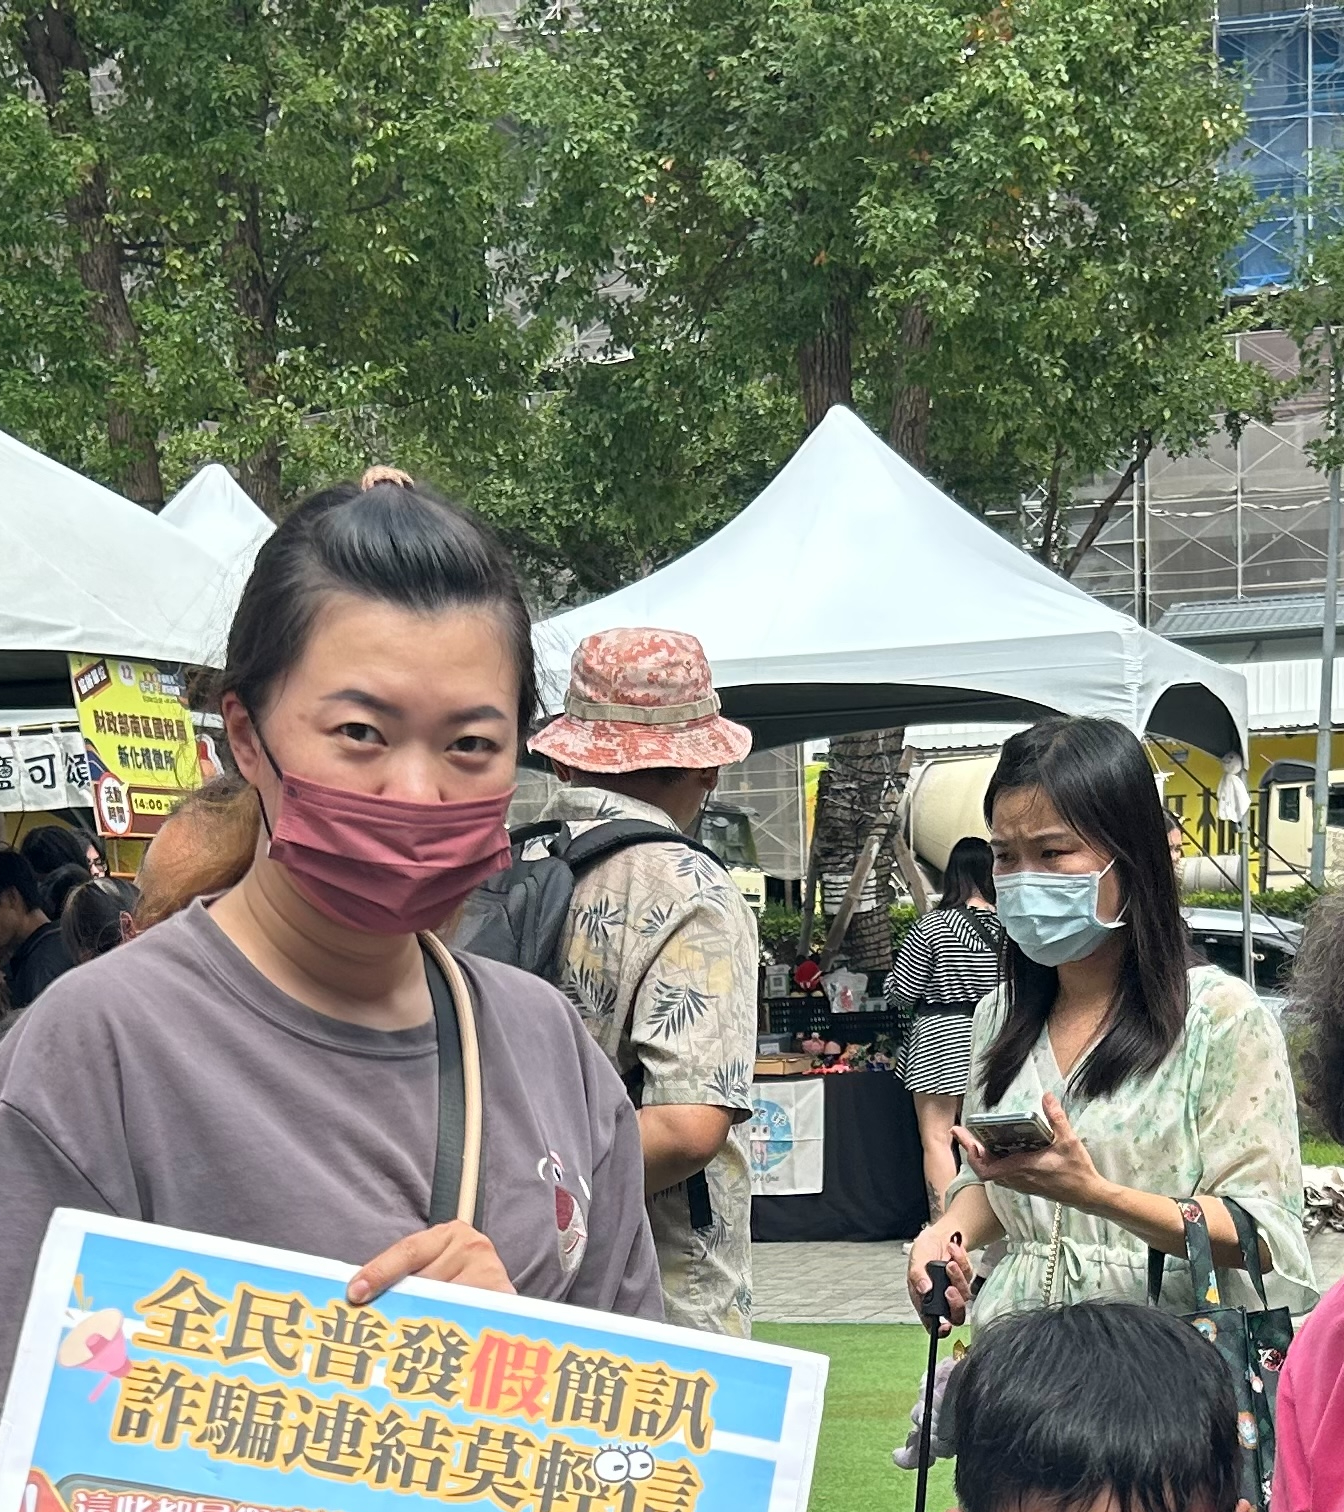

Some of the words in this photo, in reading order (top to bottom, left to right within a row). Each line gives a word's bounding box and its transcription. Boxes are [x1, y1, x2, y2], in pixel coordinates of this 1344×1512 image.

[130, 1273, 717, 1450] 全民普發假簡訊
